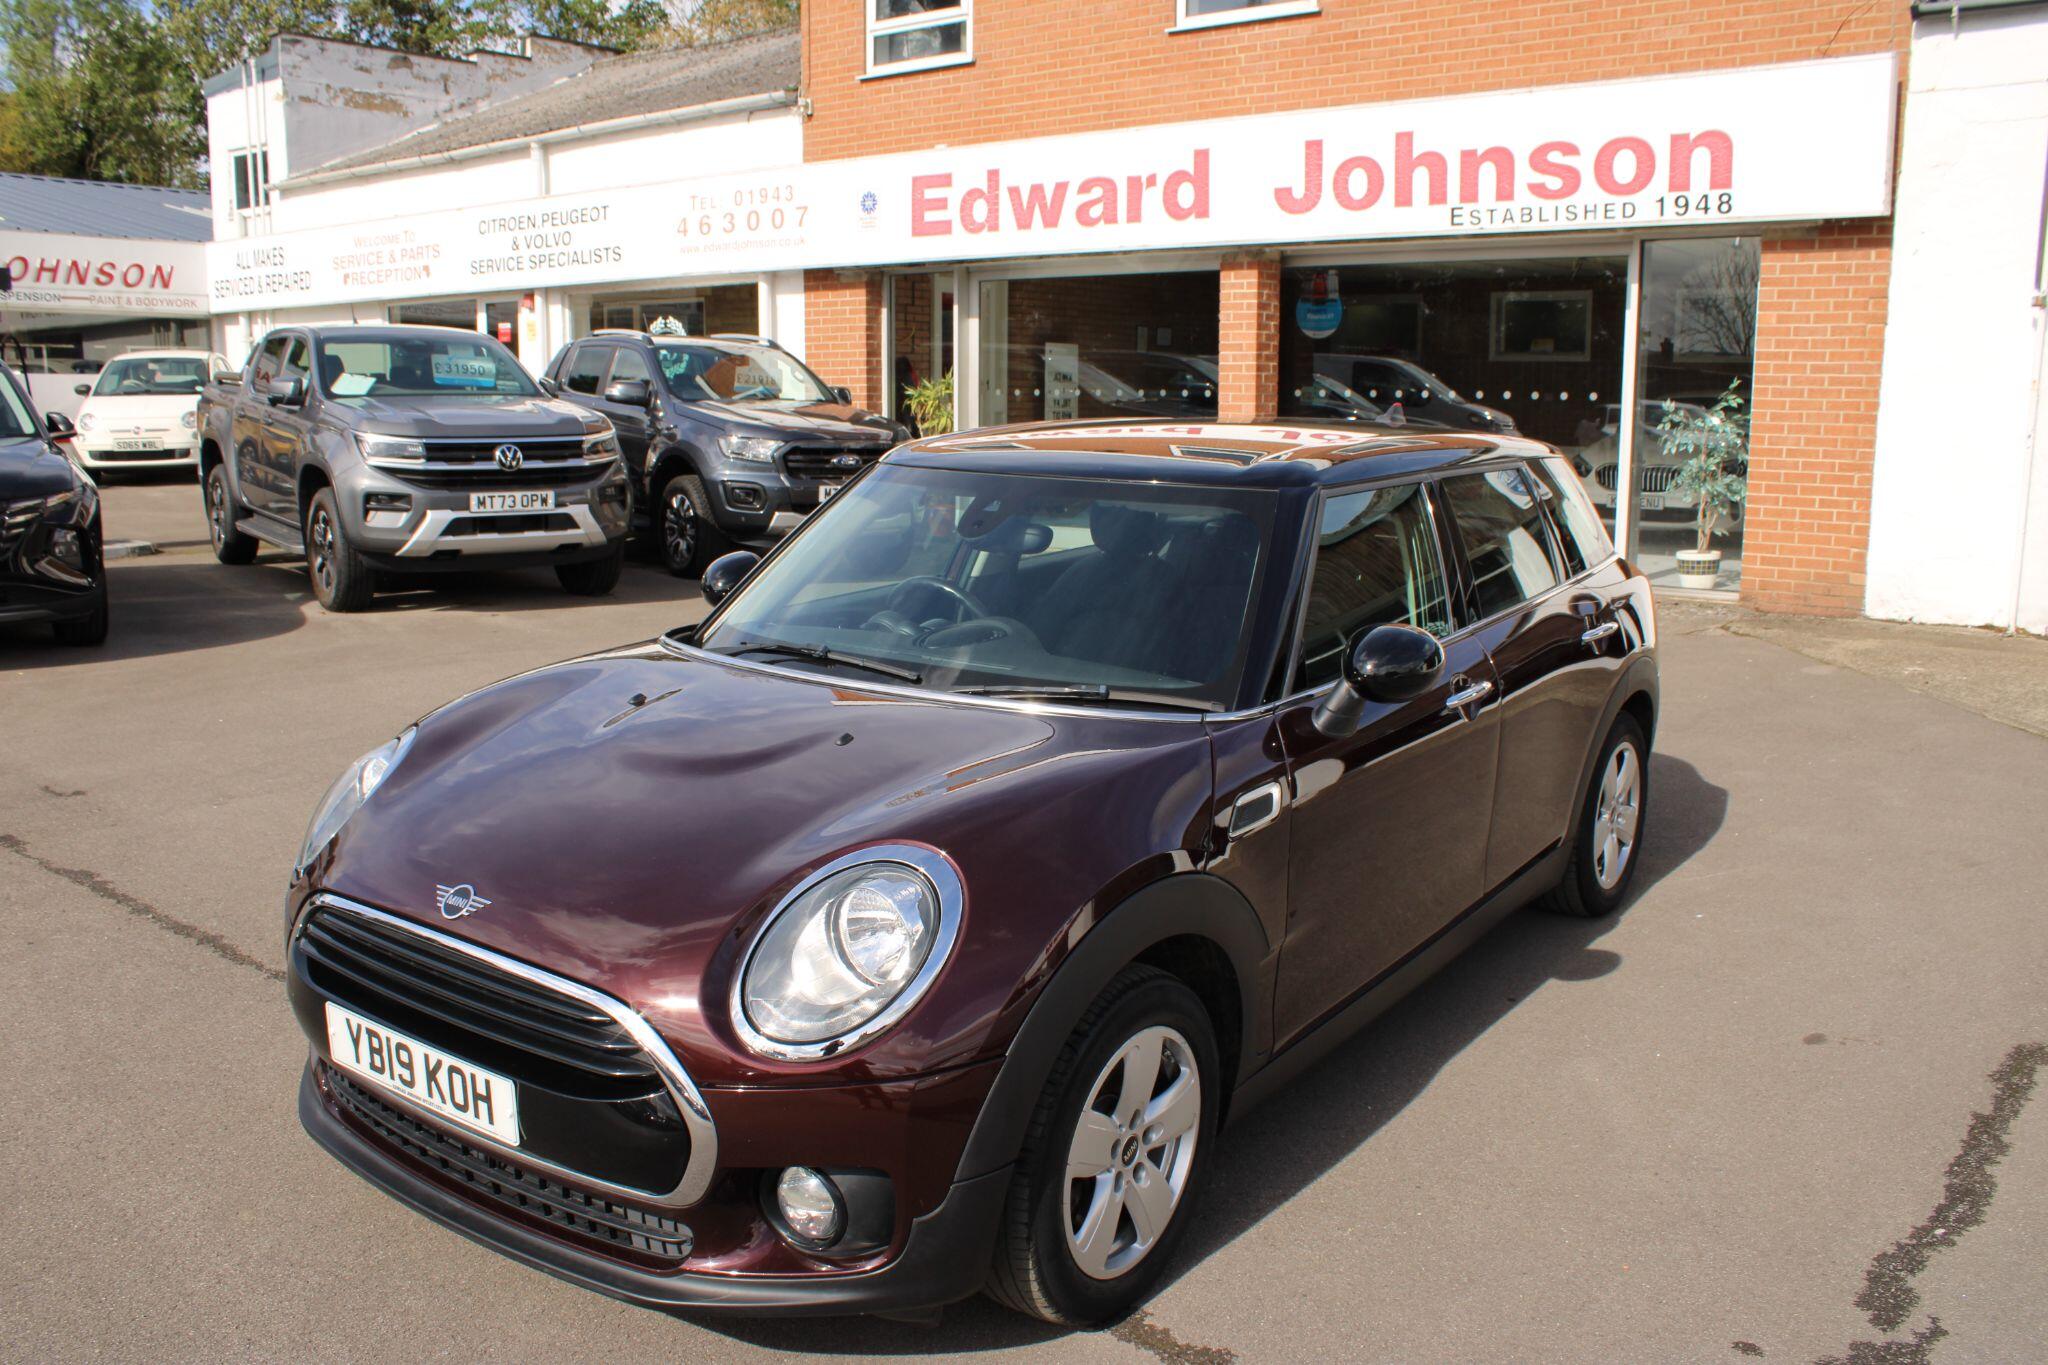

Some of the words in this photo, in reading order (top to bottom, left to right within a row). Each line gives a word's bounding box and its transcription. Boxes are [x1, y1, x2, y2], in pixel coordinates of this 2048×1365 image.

[911, 148, 1210, 237] Edward
[1274, 129, 1734, 215] Johnson
[734, 184, 794, 207] 01943
[677, 205, 809, 237] 463007
[1450, 202, 1637, 227] ESTABLISHED
[1656, 192, 1734, 218] 1948
[353, 233, 401, 248] WELCOME
[511, 236, 520, 251] &
[524, 231, 572, 250] VOLVO
[236, 249, 252, 270] ALL
[253, 246, 285, 268] MAKES
[332, 250, 384, 271] SERVICE
[388, 250, 396, 264] &
[401, 244, 440, 262] PARTS
[470, 255, 524, 275] SERVICE
[528, 246, 622, 270] SPECIALISTS
[214, 276, 255, 299] SERVICED
[257, 275, 264, 295] &
[266, 270, 312, 293] REPAIRED
[351, 265, 422, 287] RECEPTION
[89, 294, 122, 305] PAINT
[125, 297, 133, 306] &
[135, 297, 198, 308] BODYWORK
[434, 362, 485, 376] £31950
[476, 494, 516, 510] MT73
[521, 493, 548, 508] OPW
[346, 1018, 416, 1090] YB19
[423, 1053, 495, 1126] KOH
